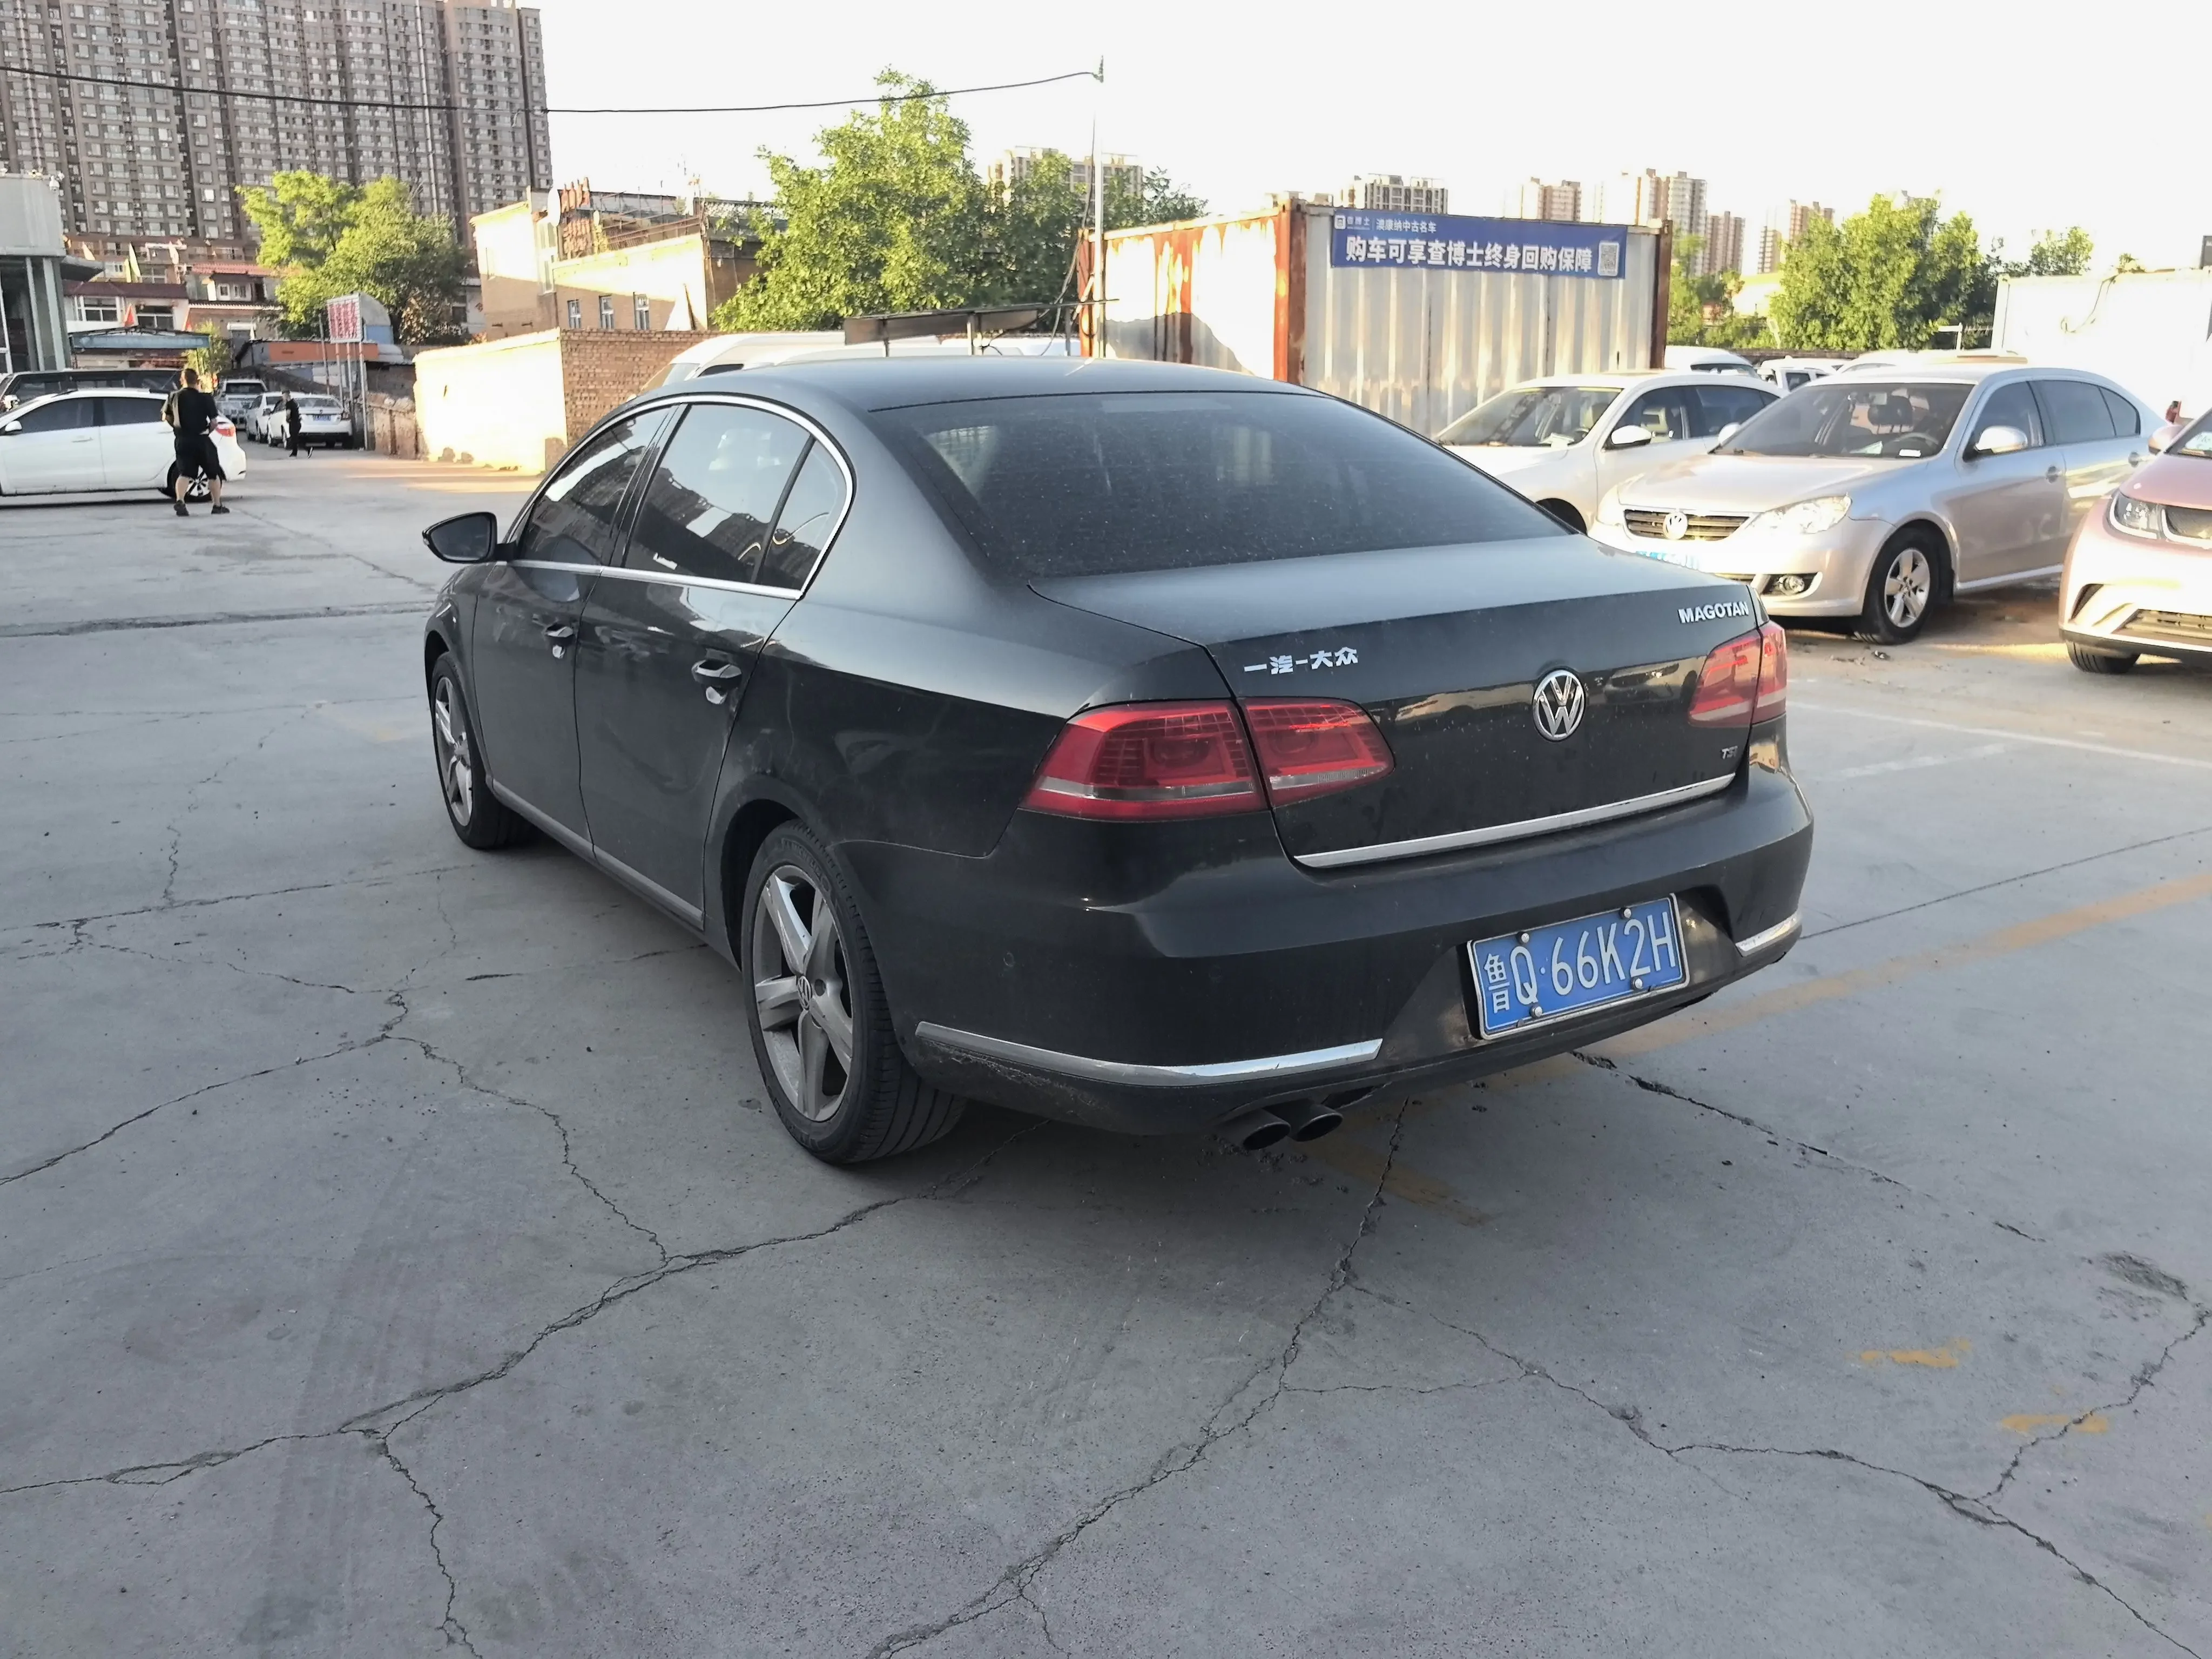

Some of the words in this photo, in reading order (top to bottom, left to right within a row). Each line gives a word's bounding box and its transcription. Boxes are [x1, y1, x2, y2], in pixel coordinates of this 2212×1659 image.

[1346, 235, 1593, 272] 购车可享查博士终身回购保障
[1678, 601, 1749, 623] MAGOTAN
